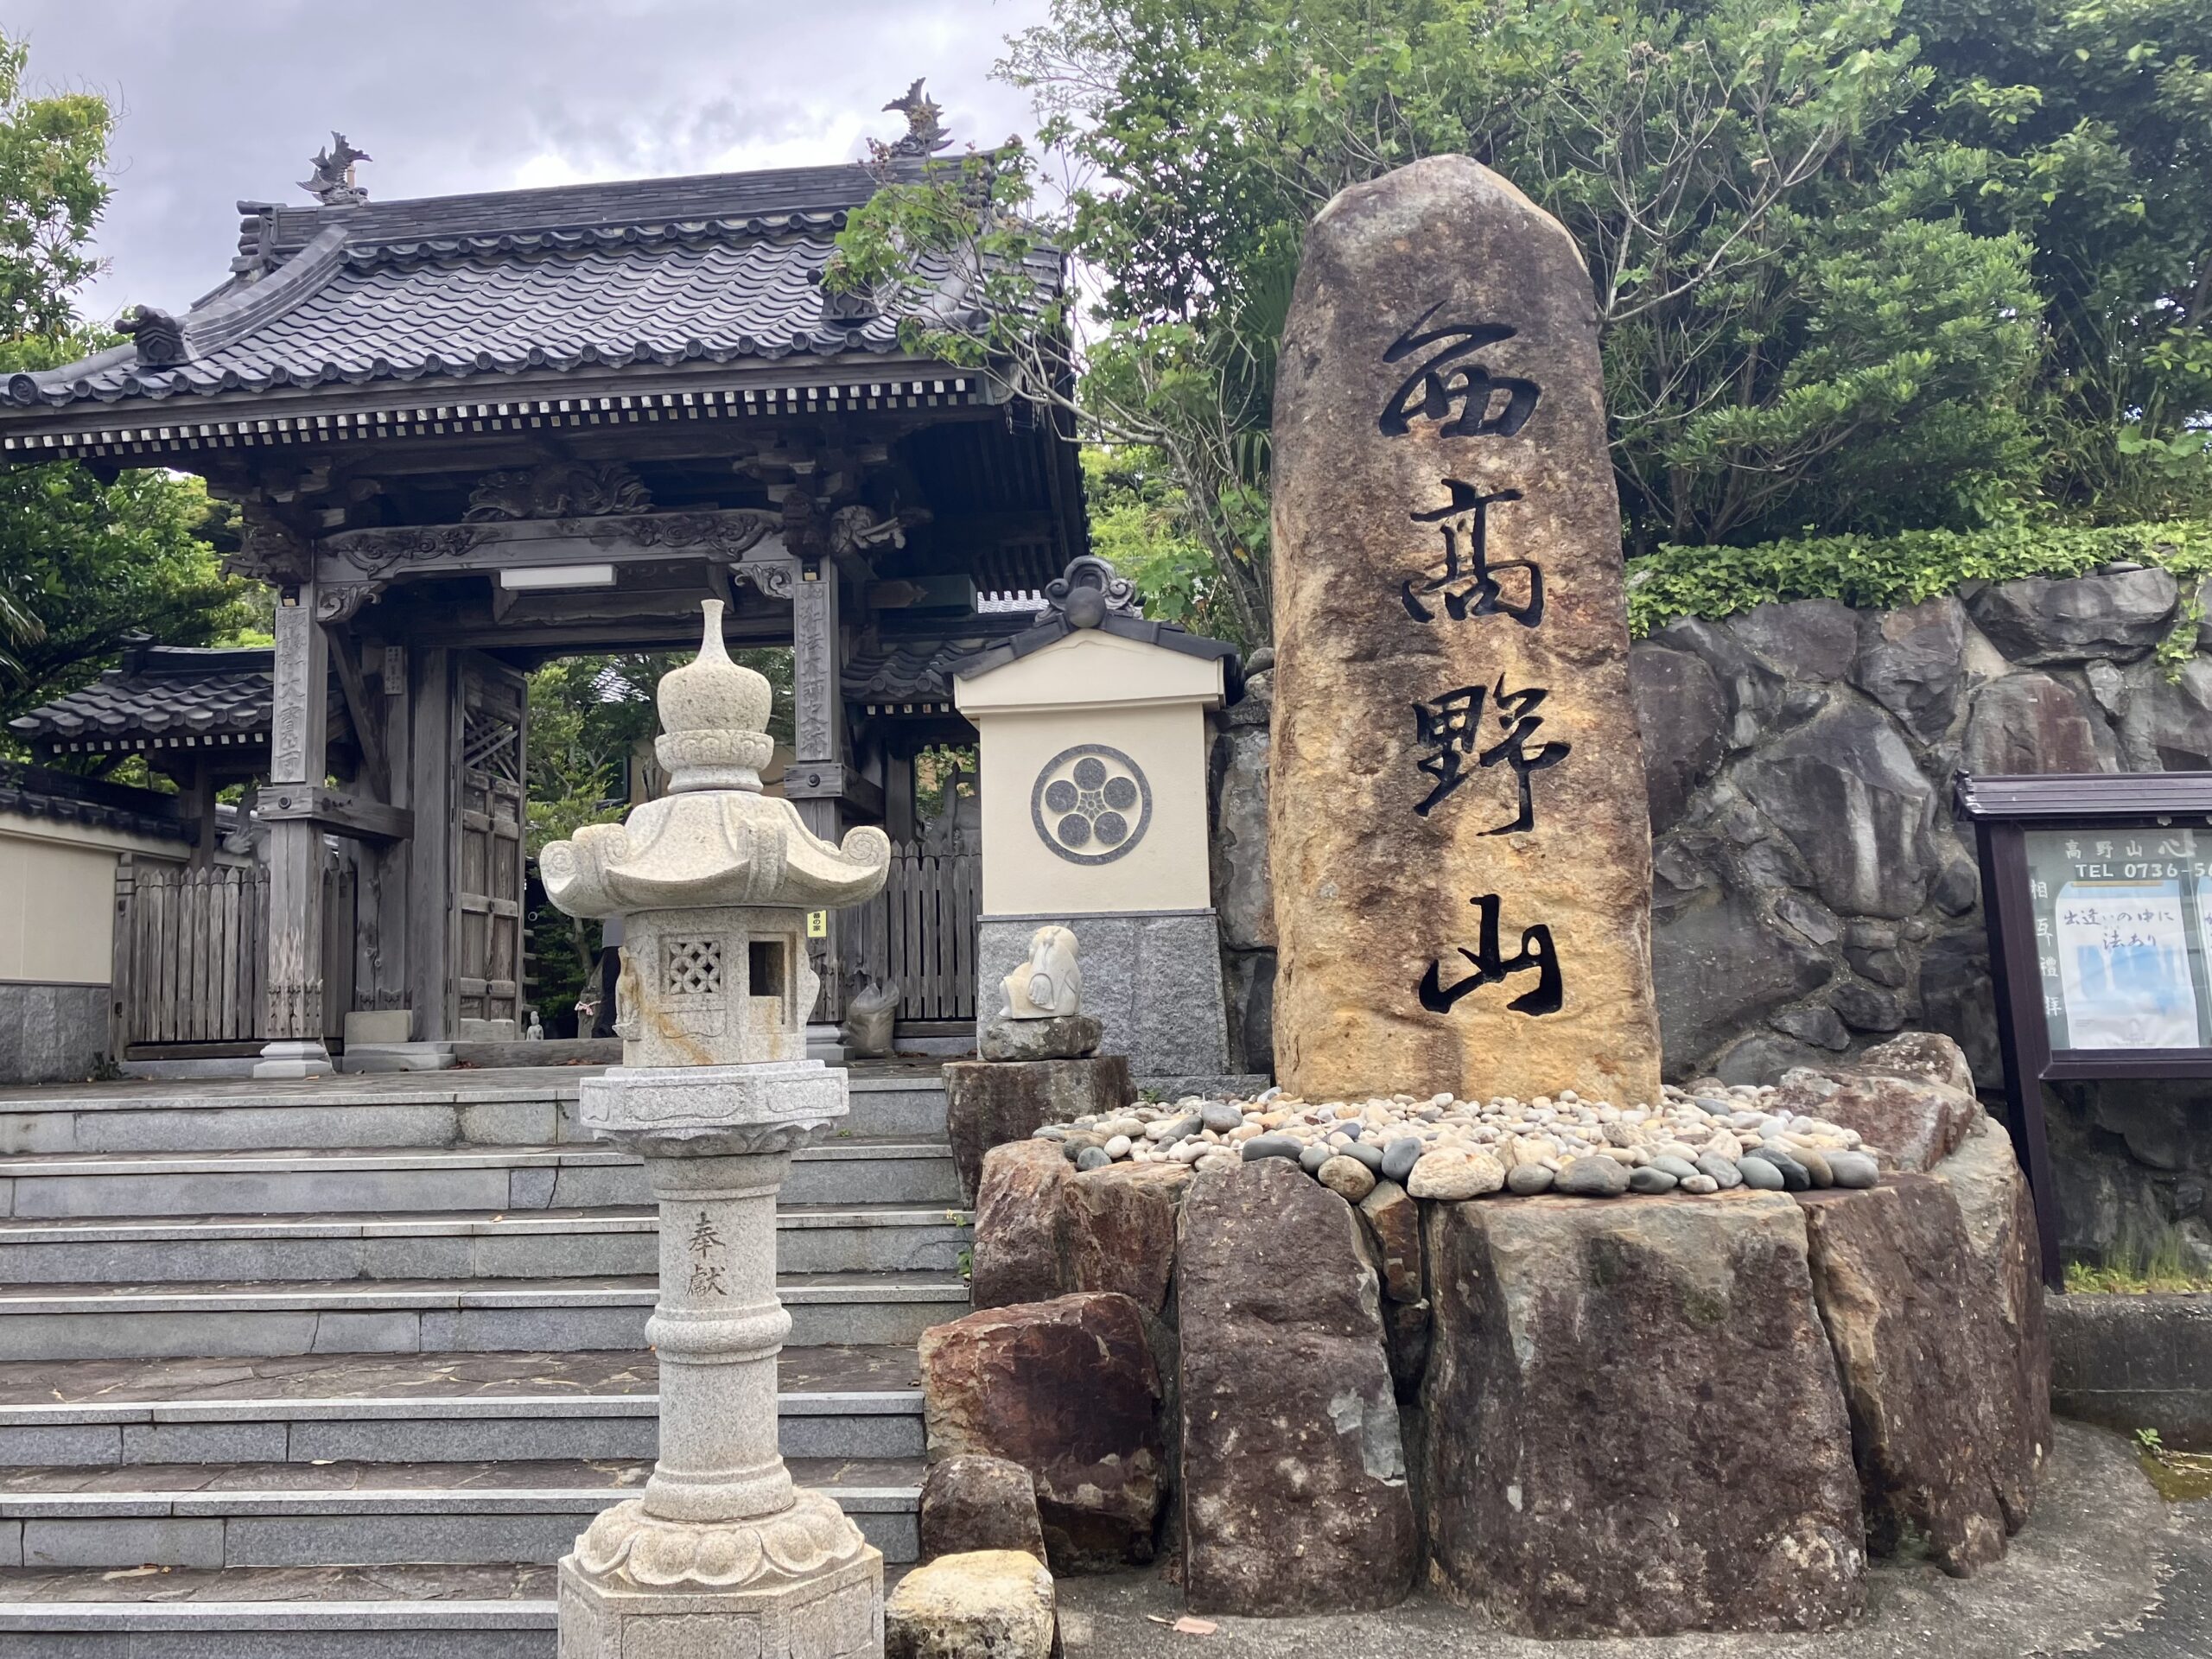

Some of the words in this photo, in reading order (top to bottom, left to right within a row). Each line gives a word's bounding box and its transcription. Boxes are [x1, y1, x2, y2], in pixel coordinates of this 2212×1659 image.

[1380, 301, 1571, 1017] 西高野山
[2075, 864, 2113, 877] TEL
[2103, 930, 2156, 950] 法あり
